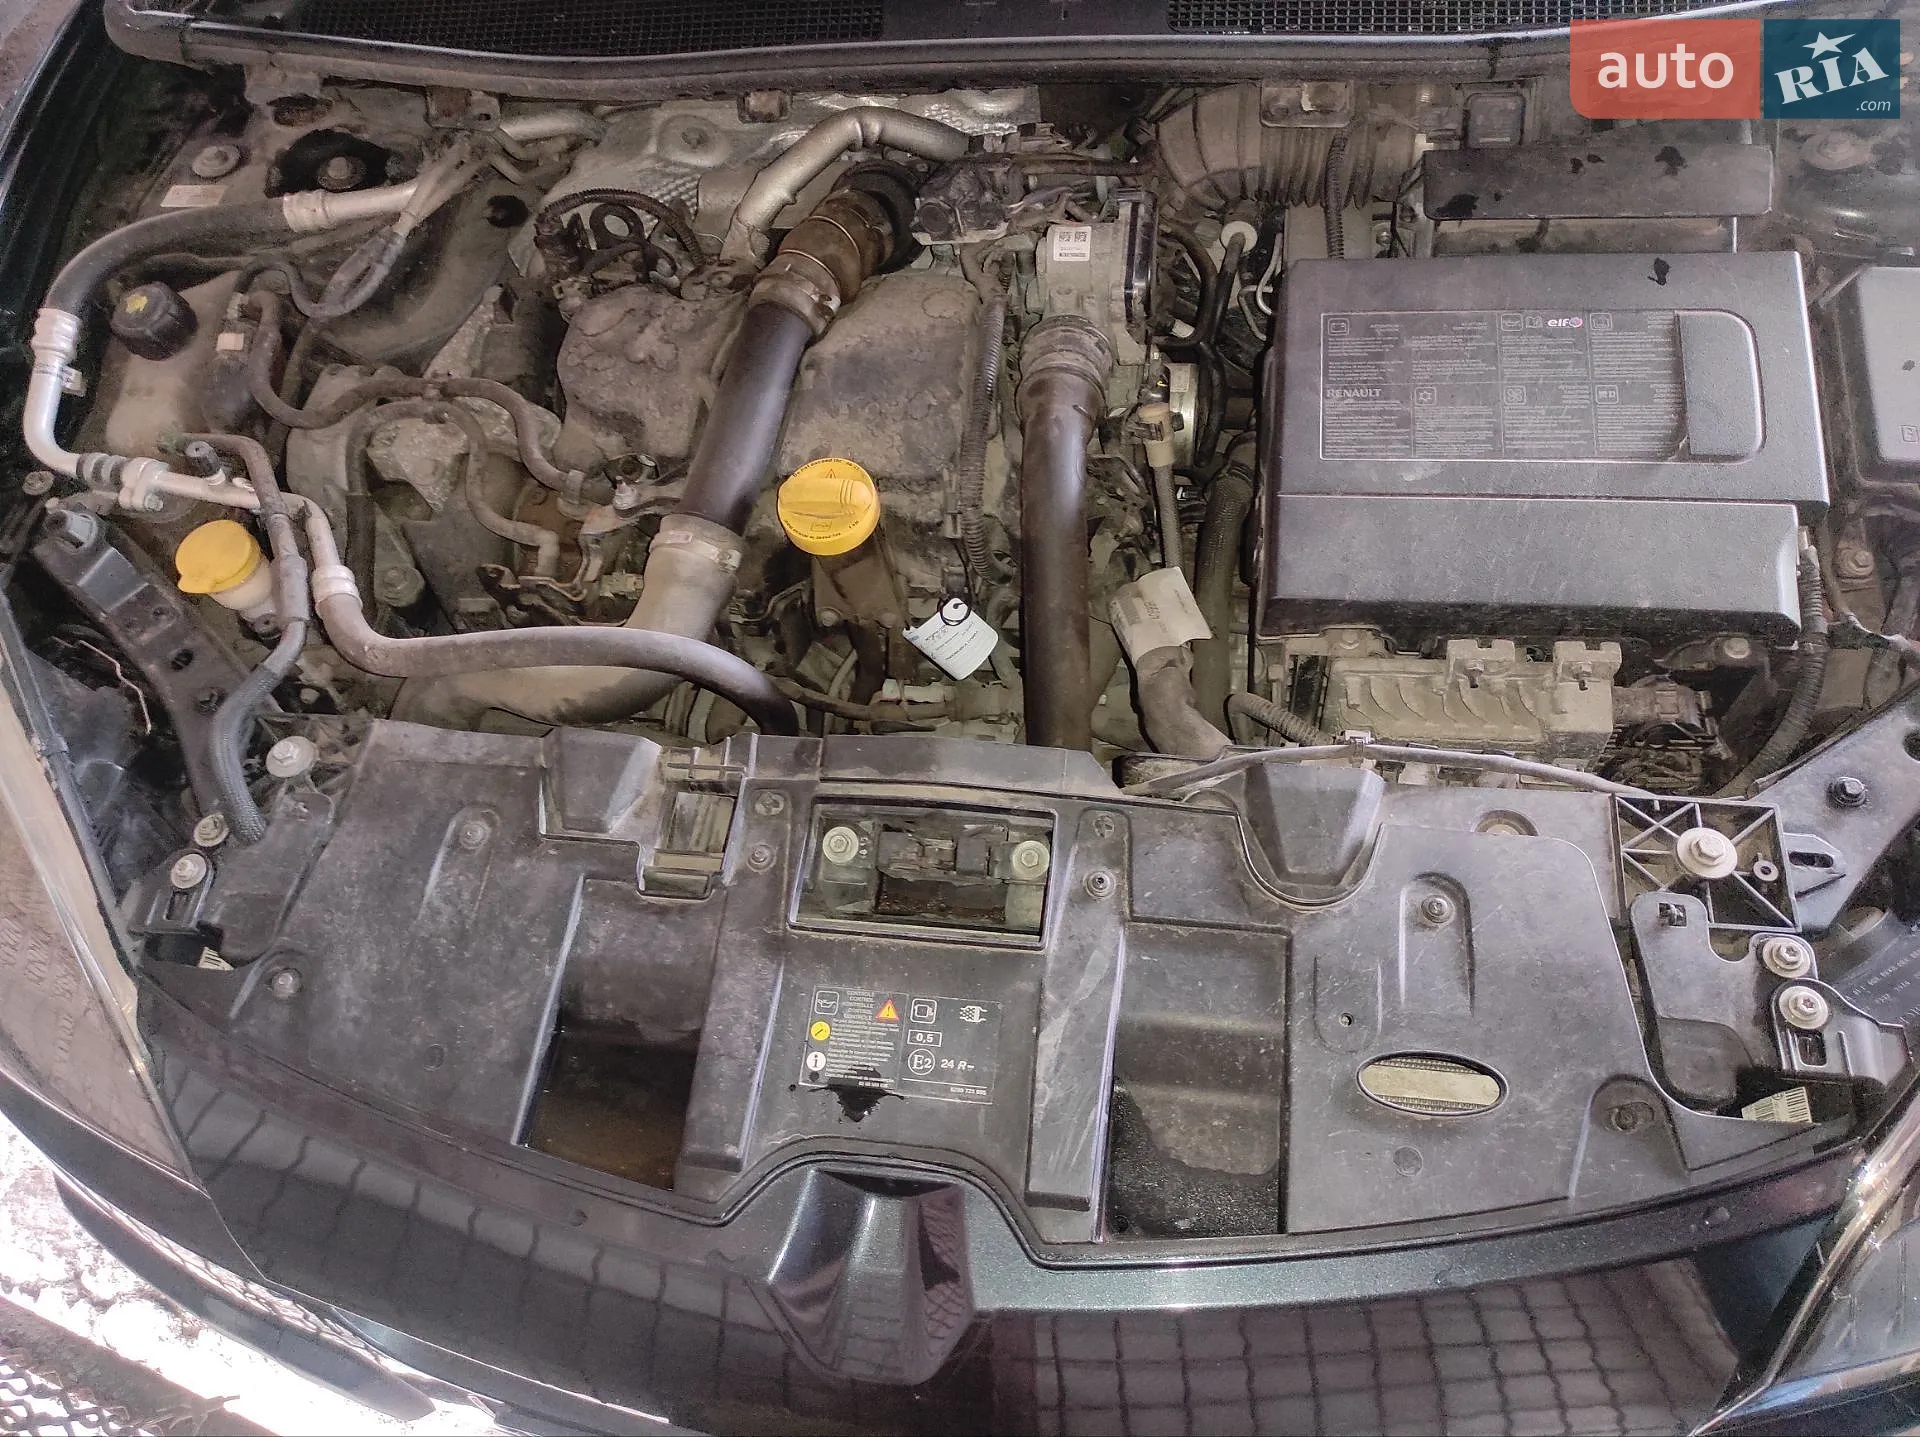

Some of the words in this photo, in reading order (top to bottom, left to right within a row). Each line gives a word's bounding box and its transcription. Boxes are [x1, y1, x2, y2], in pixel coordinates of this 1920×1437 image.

[1547, 317, 1569, 327] elf
[1326, 388, 1382, 397] RENAULT
[915, 1033, 934, 1044] 0,5
[912, 1054, 932, 1070] E2
[940, 1058, 955, 1069] 24
